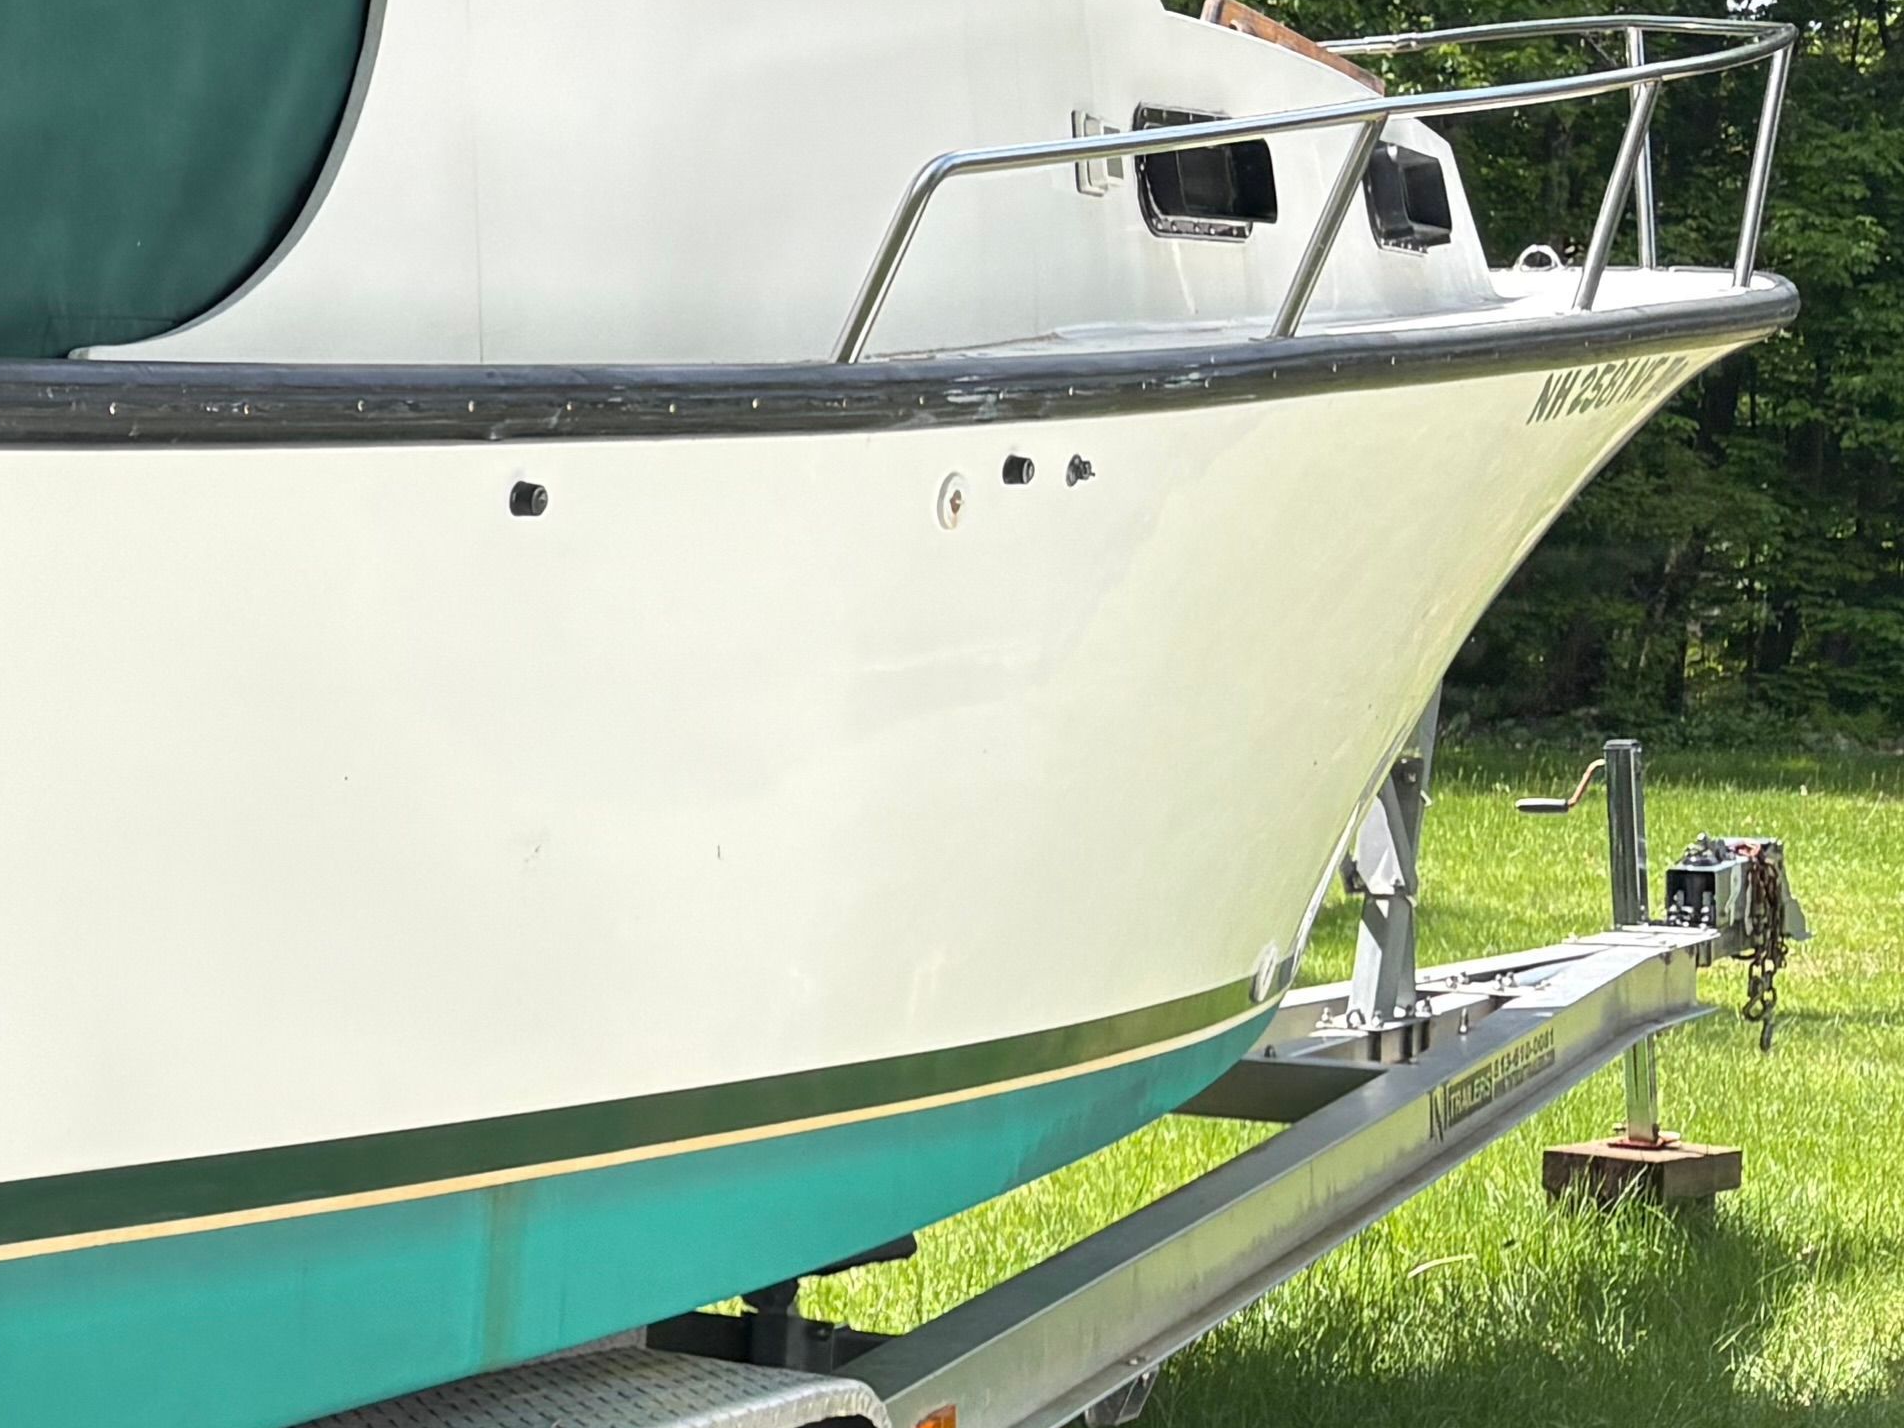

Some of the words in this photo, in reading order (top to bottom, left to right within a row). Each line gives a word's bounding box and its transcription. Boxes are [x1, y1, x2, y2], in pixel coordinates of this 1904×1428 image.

[1526, 368, 1582, 425] NH
[1566, 357, 1640, 416] 2581
[1450, 1070, 1492, 1120] TRAILERS
